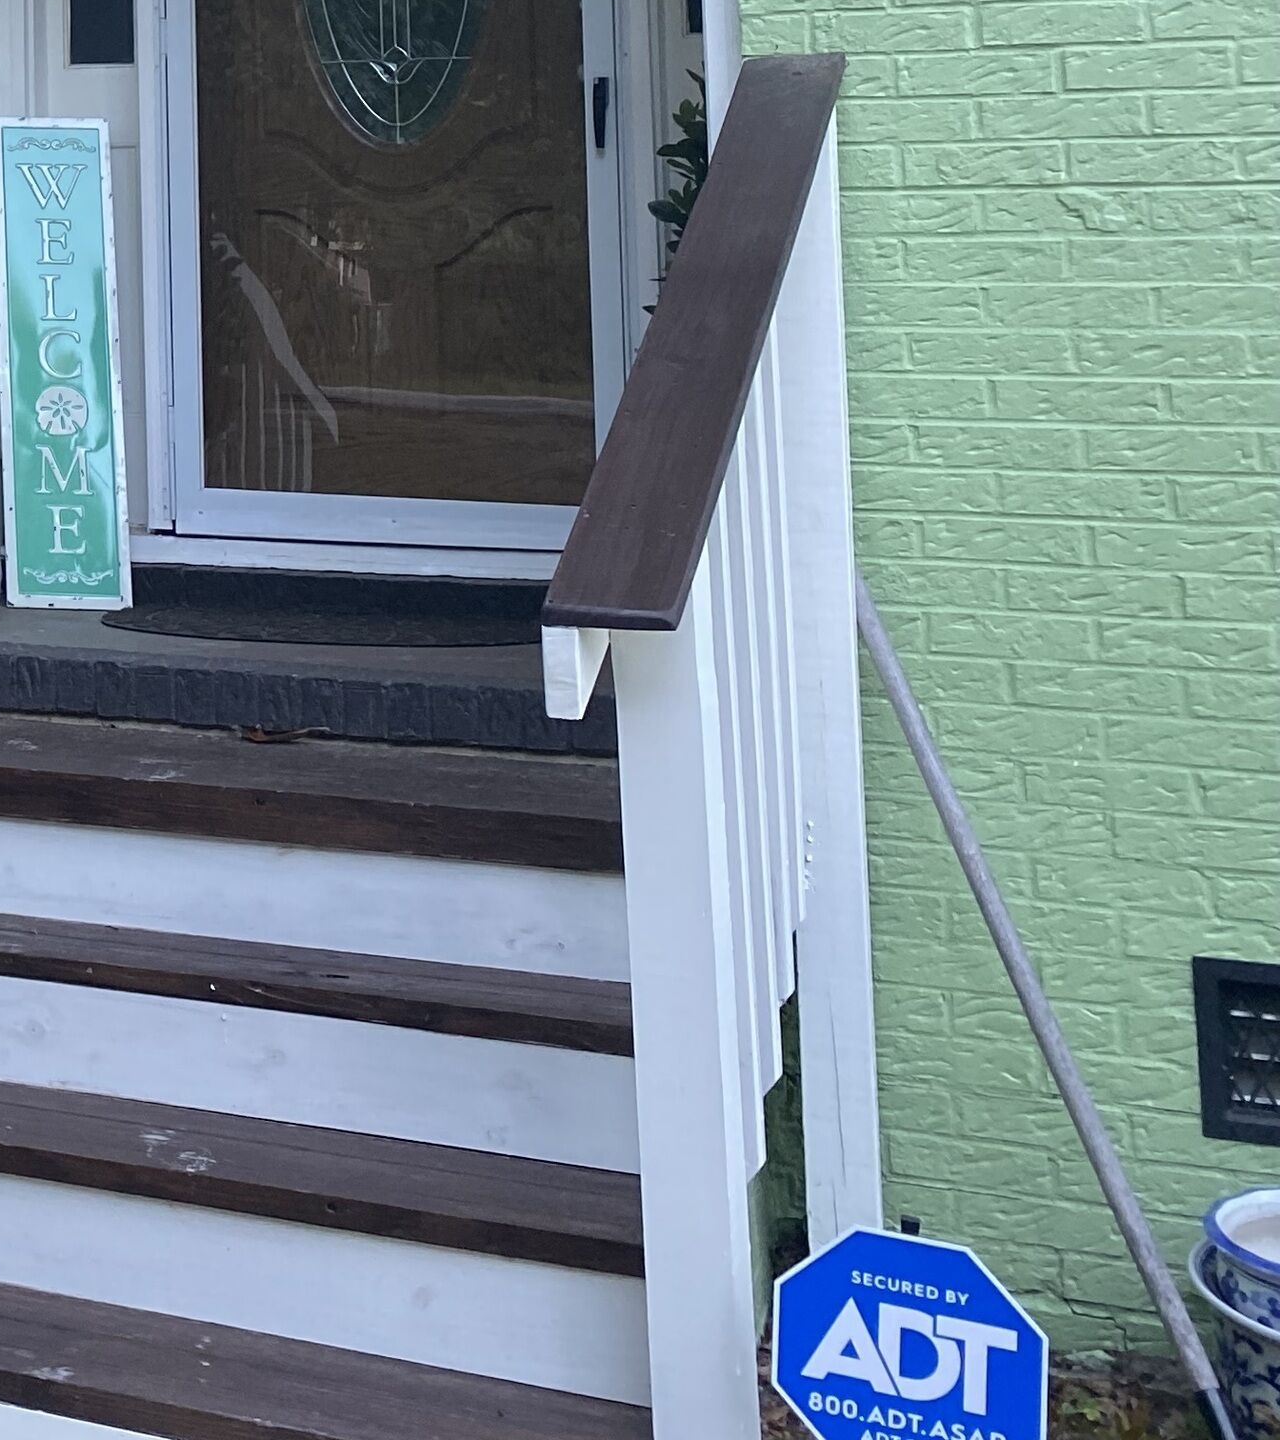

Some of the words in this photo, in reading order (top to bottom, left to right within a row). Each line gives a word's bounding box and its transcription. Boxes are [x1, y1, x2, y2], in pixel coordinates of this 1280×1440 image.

[851, 1269, 939, 1300] SECURED
[945, 1289, 970, 1307] BY
[800, 1296, 1019, 1417] ADT
